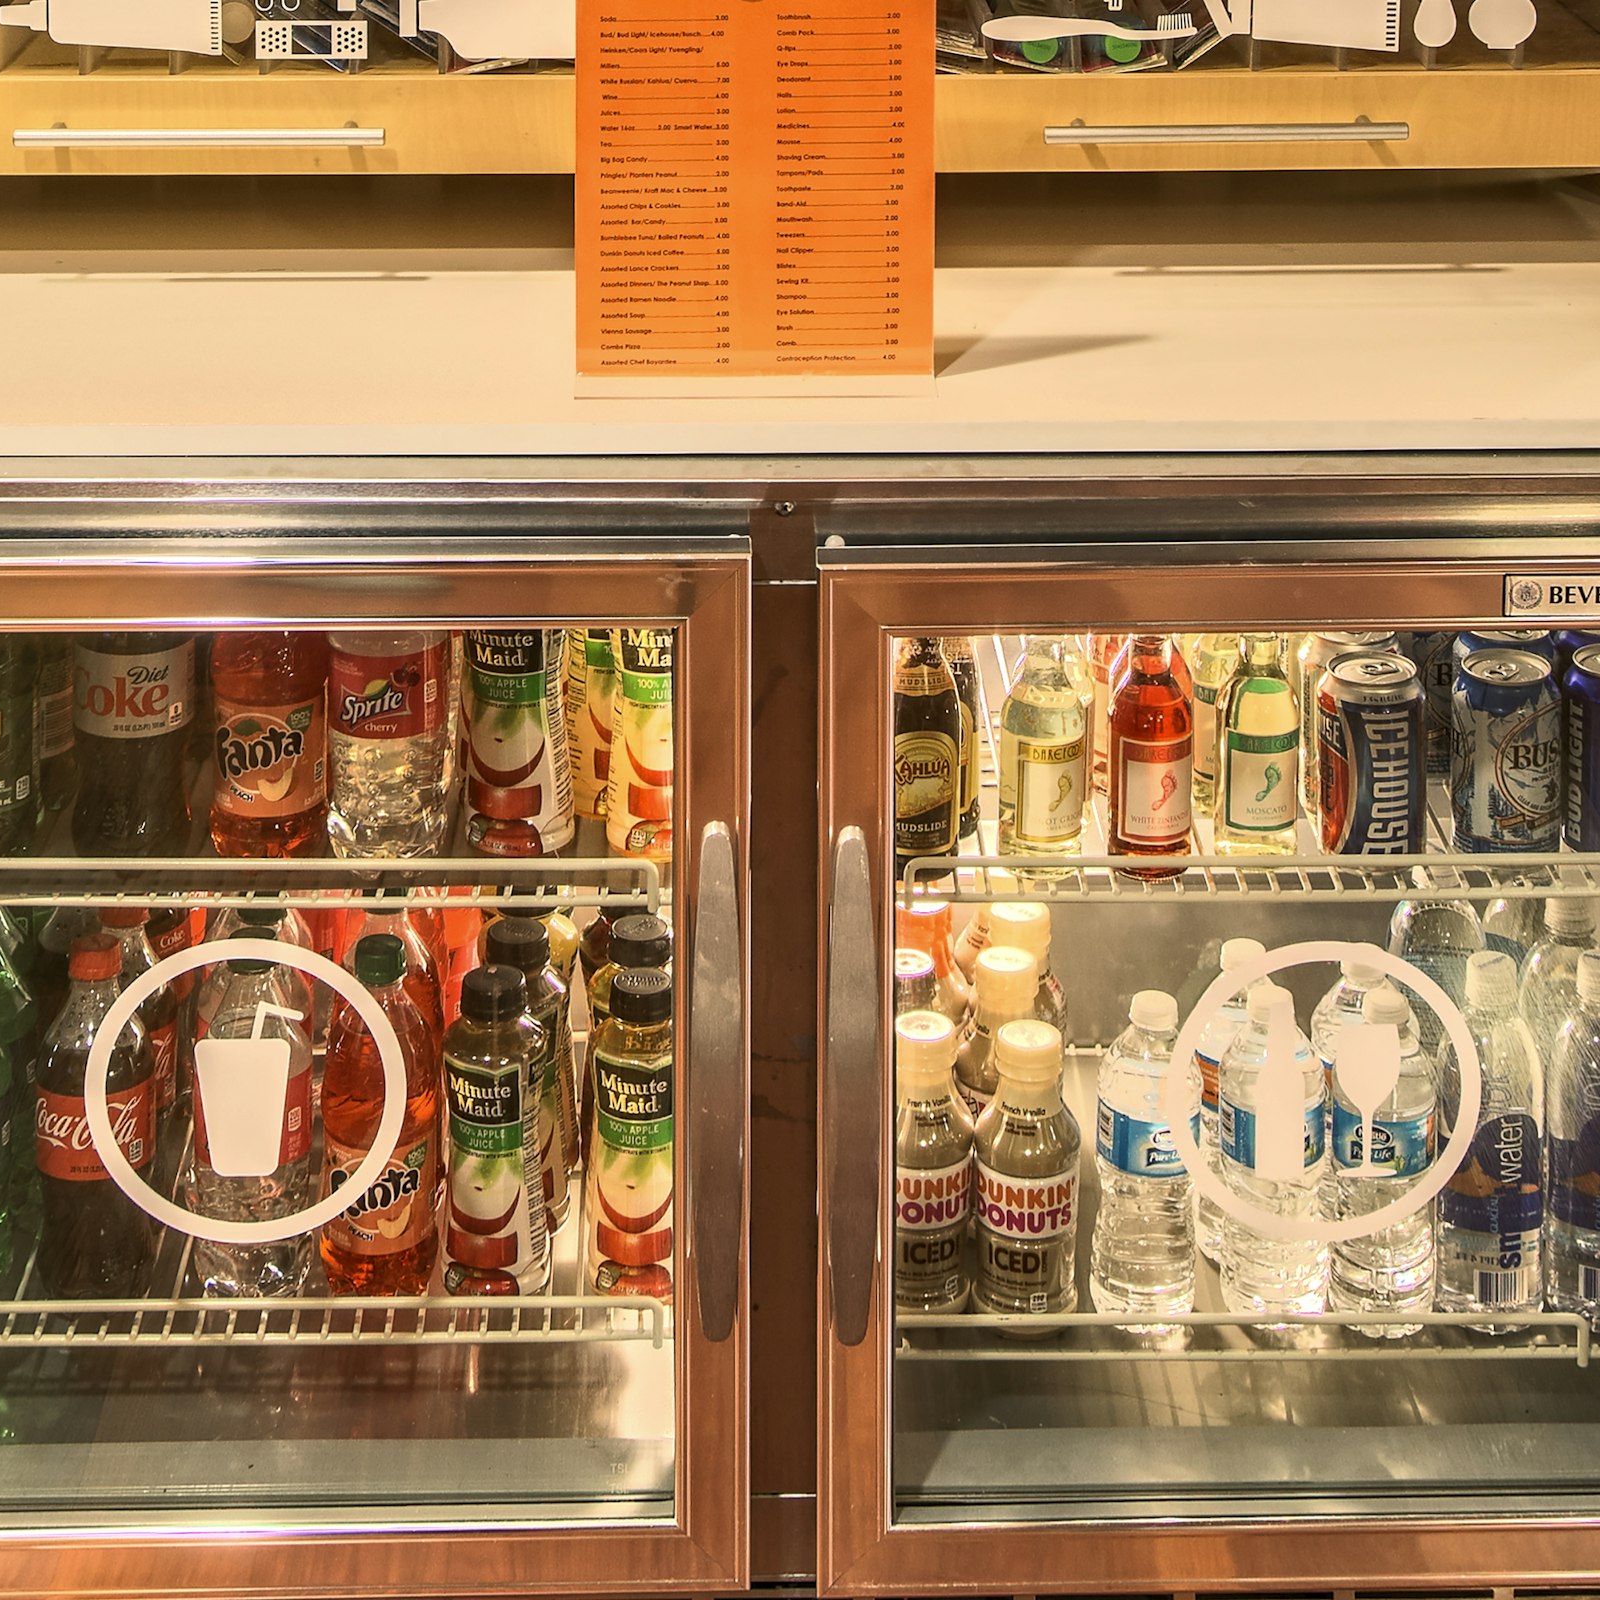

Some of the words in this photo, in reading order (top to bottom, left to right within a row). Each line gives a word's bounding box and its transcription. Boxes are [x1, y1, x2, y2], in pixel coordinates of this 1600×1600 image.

[128, 665, 169, 686] Diet
[73, 665, 169, 718] Coke
[341, 686, 403, 727] Sprite
[364, 723, 398, 734] cherry
[1567, 701, 1583, 780] LIGHT
[217, 725, 303, 779] Fanta
[229, 785, 254, 802] PEACH
[1366, 711, 1409, 853] ICEHOUSE
[1246, 805, 1288, 816] MOSCATO
[1567, 788, 1582, 842] BUD
[450, 1072, 511, 1100] Minute
[458, 1098, 504, 1118] Maid
[1001, 1101, 1021, 1115] French
[1022, 1104, 1046, 1117] Vanilla
[468, 1137, 494, 1149] JUICE
[482, 1129, 505, 1138] APPLE
[1494, 1114, 1522, 1183] water
[977, 1202, 1071, 1233] DONUTS
[989, 1248, 1047, 1273] ICED!
